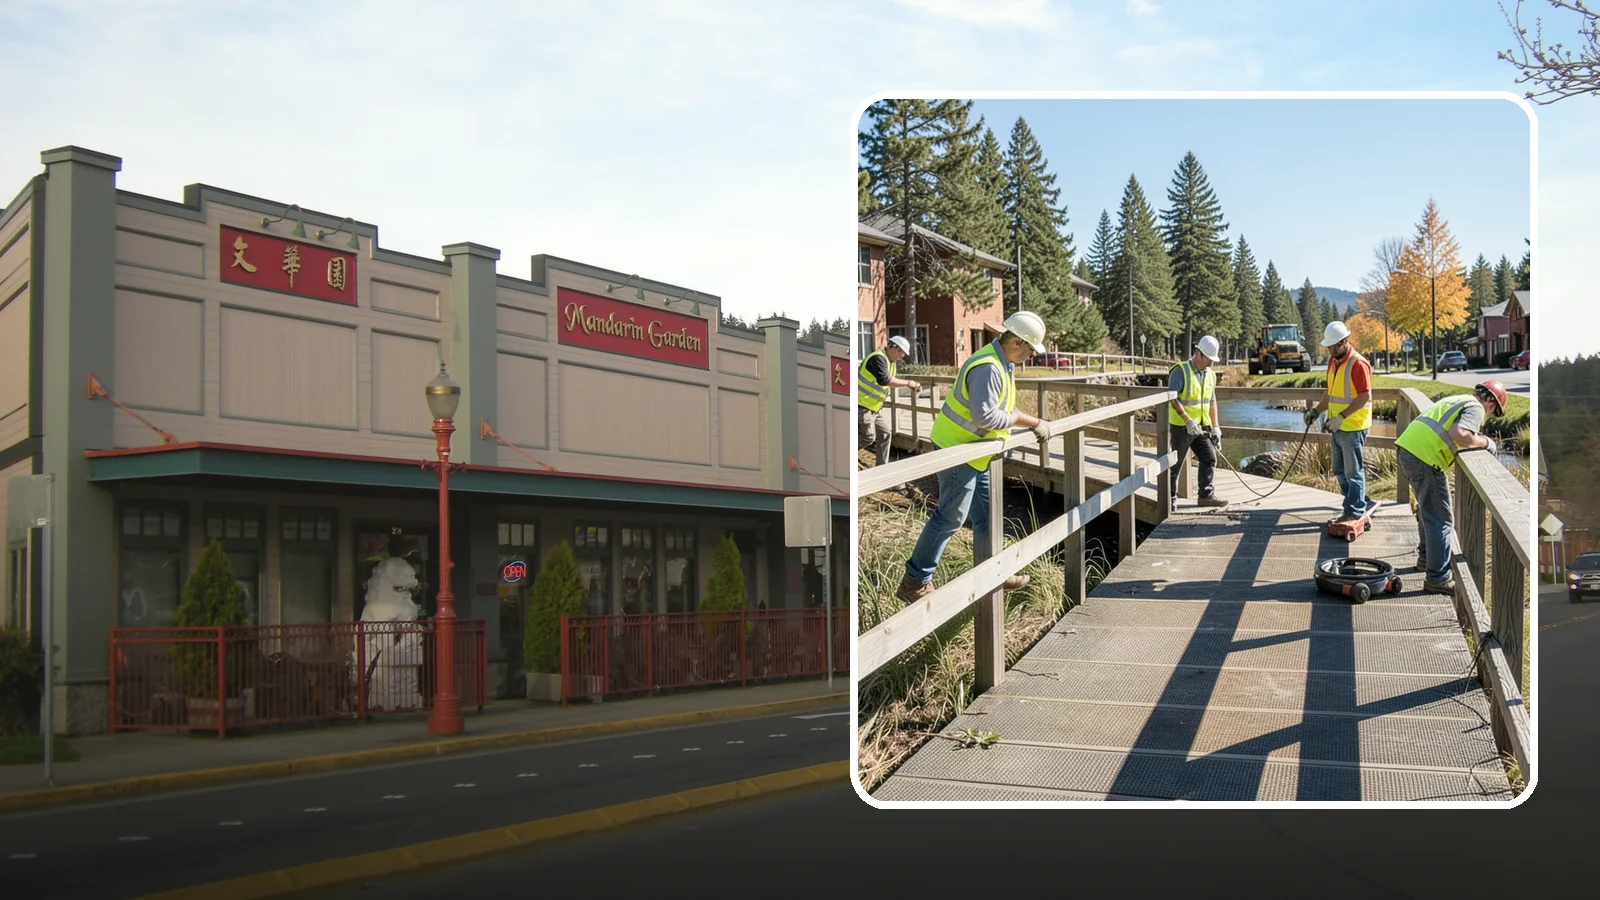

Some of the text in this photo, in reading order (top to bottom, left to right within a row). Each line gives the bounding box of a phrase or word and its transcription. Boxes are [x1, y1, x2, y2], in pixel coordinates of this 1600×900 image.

[231, 235, 346, 291] 文華園
[564, 302, 701, 352] Mandarin Garden
[503, 565, 527, 578] OPEN
